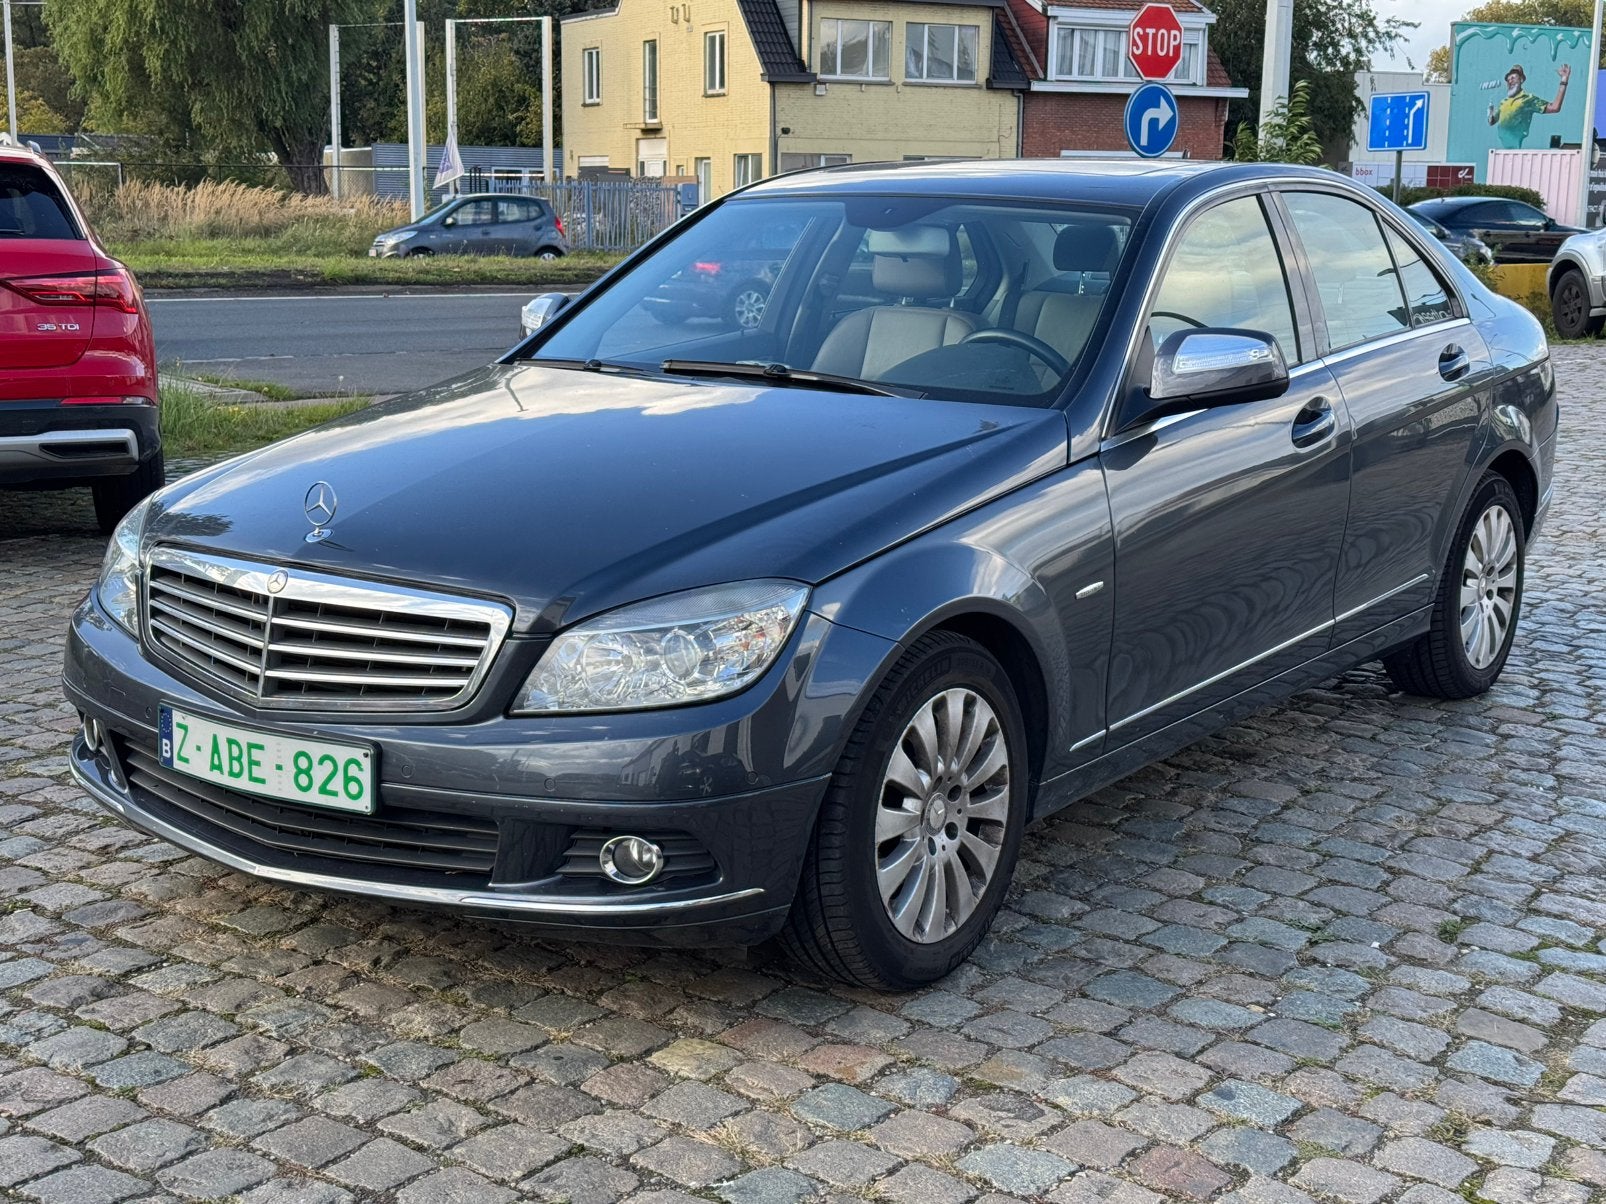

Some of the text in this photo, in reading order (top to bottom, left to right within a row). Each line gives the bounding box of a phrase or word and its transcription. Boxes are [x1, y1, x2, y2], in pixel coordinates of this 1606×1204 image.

[1133, 27, 1181, 57] STOP
[37, 323, 80, 331] 35 TDI
[162, 738, 171, 758] B
[175, 721, 365, 801] Z-ABE-826
